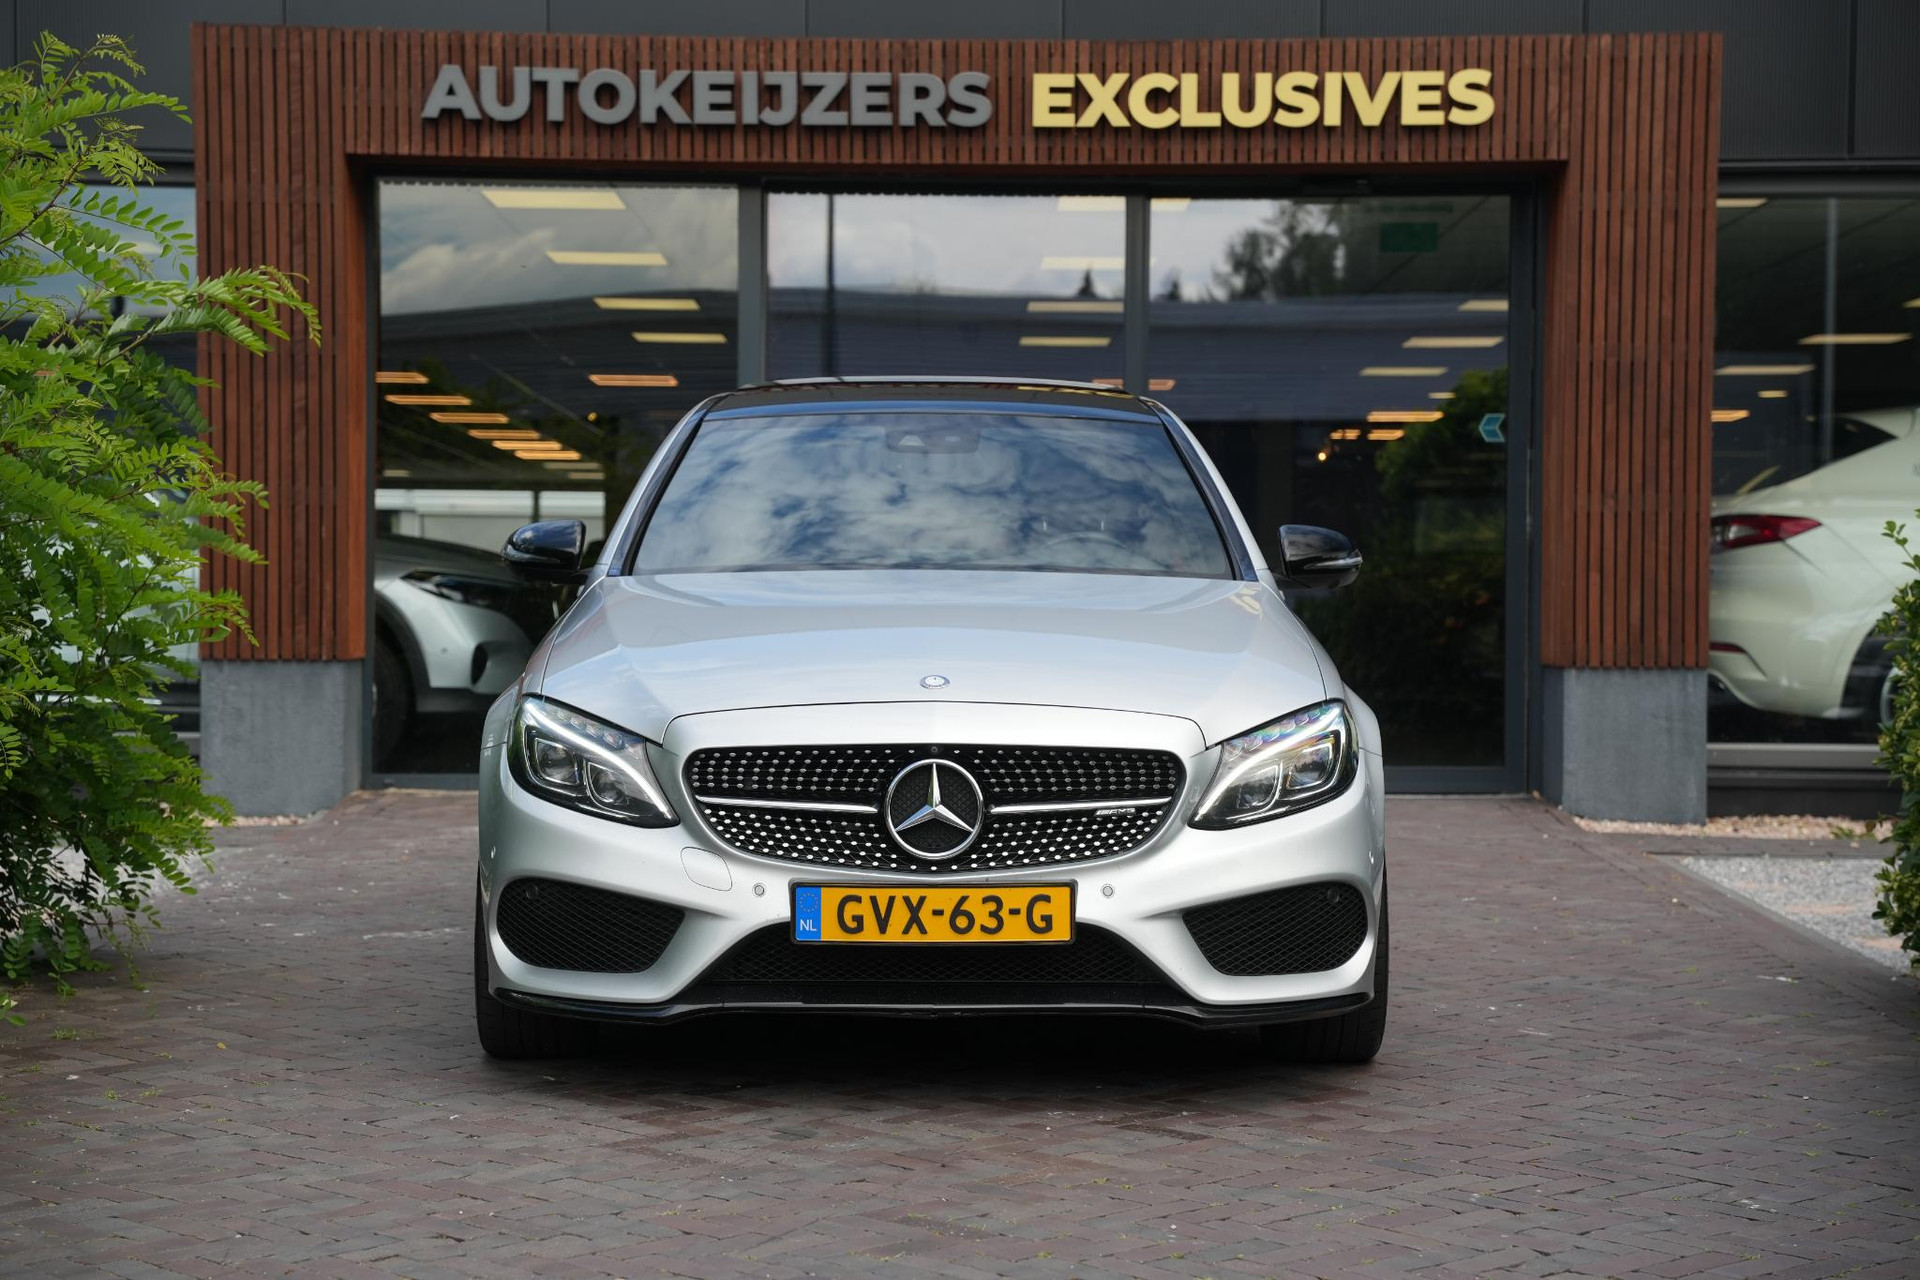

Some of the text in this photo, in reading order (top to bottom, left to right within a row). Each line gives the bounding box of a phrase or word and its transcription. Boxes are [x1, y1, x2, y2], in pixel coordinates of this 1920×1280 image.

[420, 64, 1496, 129] AUTOKEIJZERS EXCLUSIVES
[800, 919, 817, 932] NL
[836, 893, 1054, 935] GVX-63-G
